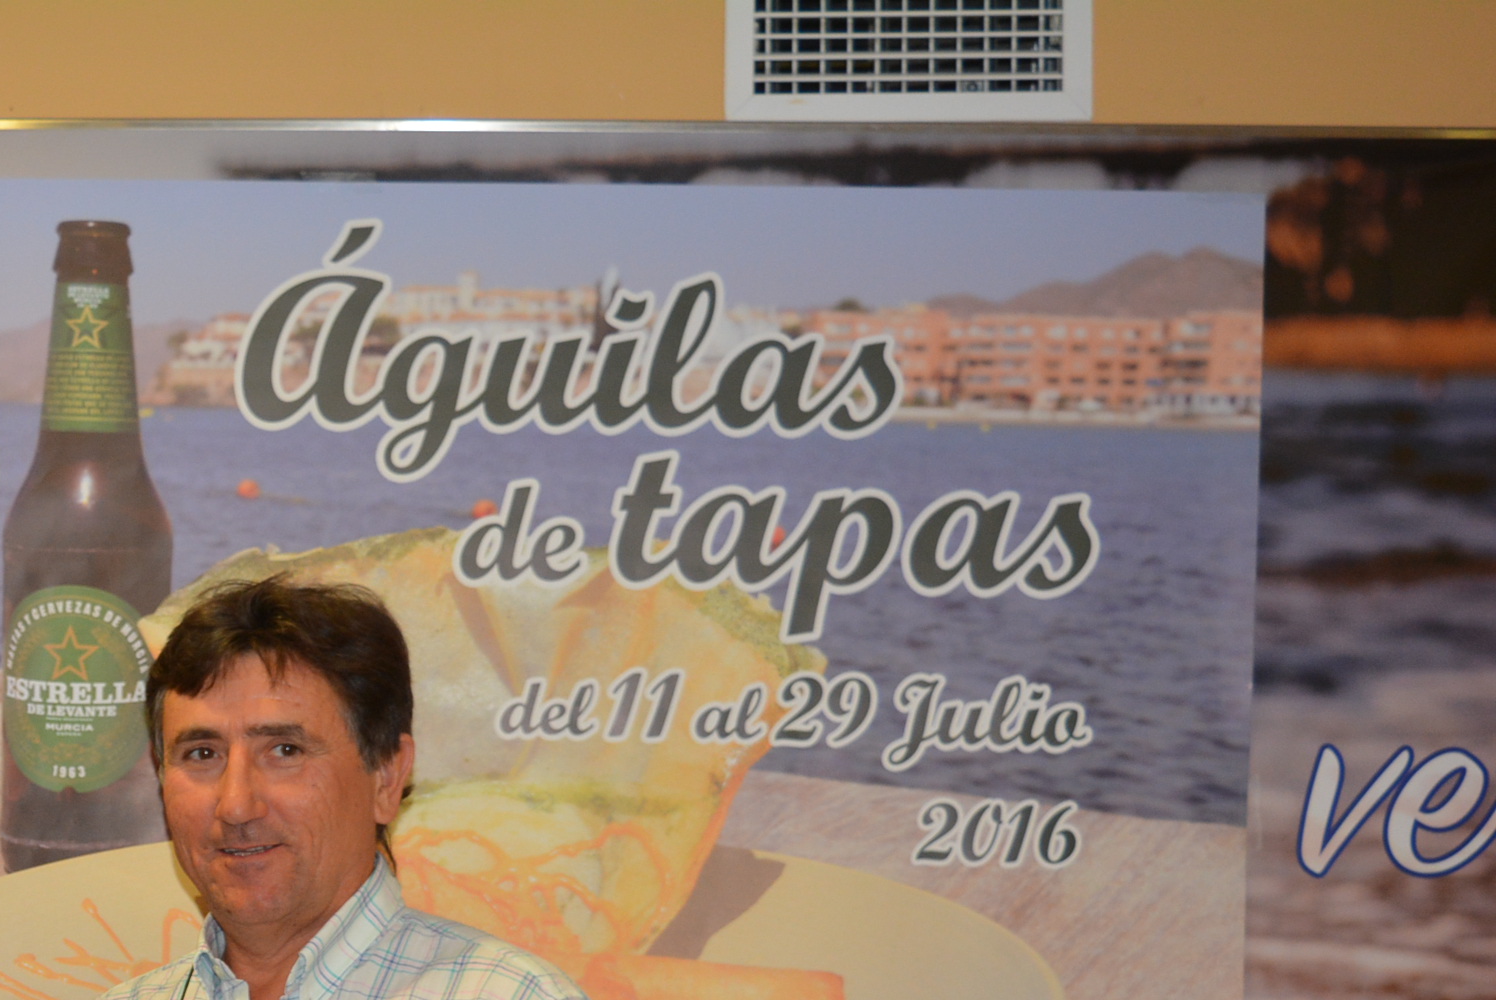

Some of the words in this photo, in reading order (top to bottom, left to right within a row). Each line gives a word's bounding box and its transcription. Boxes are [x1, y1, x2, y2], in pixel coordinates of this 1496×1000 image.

[235, 218, 902, 482] Águilas
[454, 478, 587, 586] de
[609, 450, 1100, 642] tapas
[30, 601, 102, 620] CERVEZAS
[103, 610, 122, 628] DE
[7, 676, 147, 704] ESTRELLA
[27, 703, 45, 715] DE
[47, 705, 117, 717] LEVANTE
[499, 678, 596, 741] del
[604, 668, 684, 742] 11
[692, 685, 768, 744] al
[773, 672, 877, 747] 29
[882, 672, 1092, 771] Julio
[45, 723, 94, 732] MURCIA
[53, 765, 86, 778] 1963
[913, 799, 1083, 868] 2016
